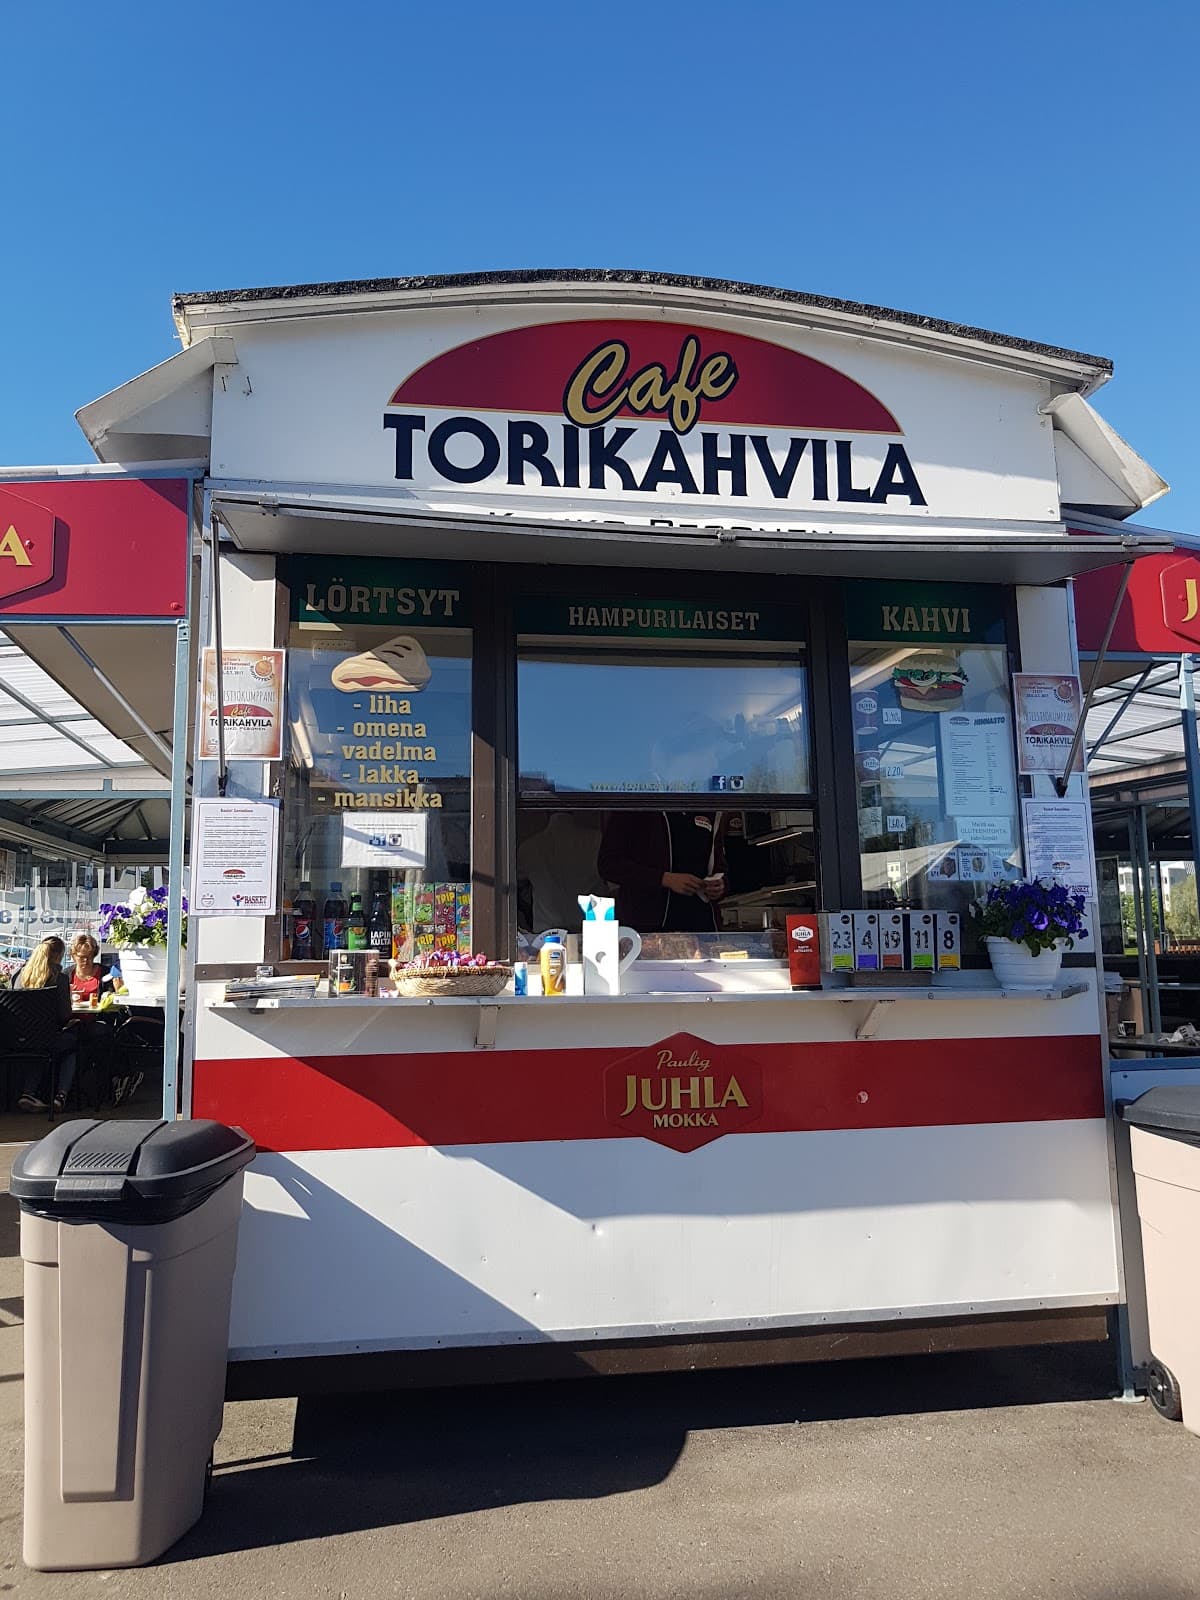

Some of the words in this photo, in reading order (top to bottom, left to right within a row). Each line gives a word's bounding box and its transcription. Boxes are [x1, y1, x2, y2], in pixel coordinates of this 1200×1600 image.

[562, 334, 739, 435] Cafe
[384, 413, 928, 507] TORIKAHVILA
[305, 577, 460, 617] LÖRTSYT
[568, 606, 760, 632] HAMPURILAISET
[881, 605, 971, 633] KAHVI
[369, 694, 412, 714] liha
[353, 721, 427, 739] omena
[341, 742, 437, 762] vadelma
[358, 765, 420, 785] lakka
[334, 790, 444, 809] mansikka
[436, 892, 456, 905] TRIP
[437, 934, 456, 948] TRIP
[832, 930, 852, 949] 23
[861, 929, 874, 950] 4
[914, 929, 929, 949] 11
[943, 929, 955, 950] 8
[656, 1050, 711, 1072] Paulig
[620, 1075, 750, 1117] JUHLA
[653, 1112, 719, 1129] MOKKA
